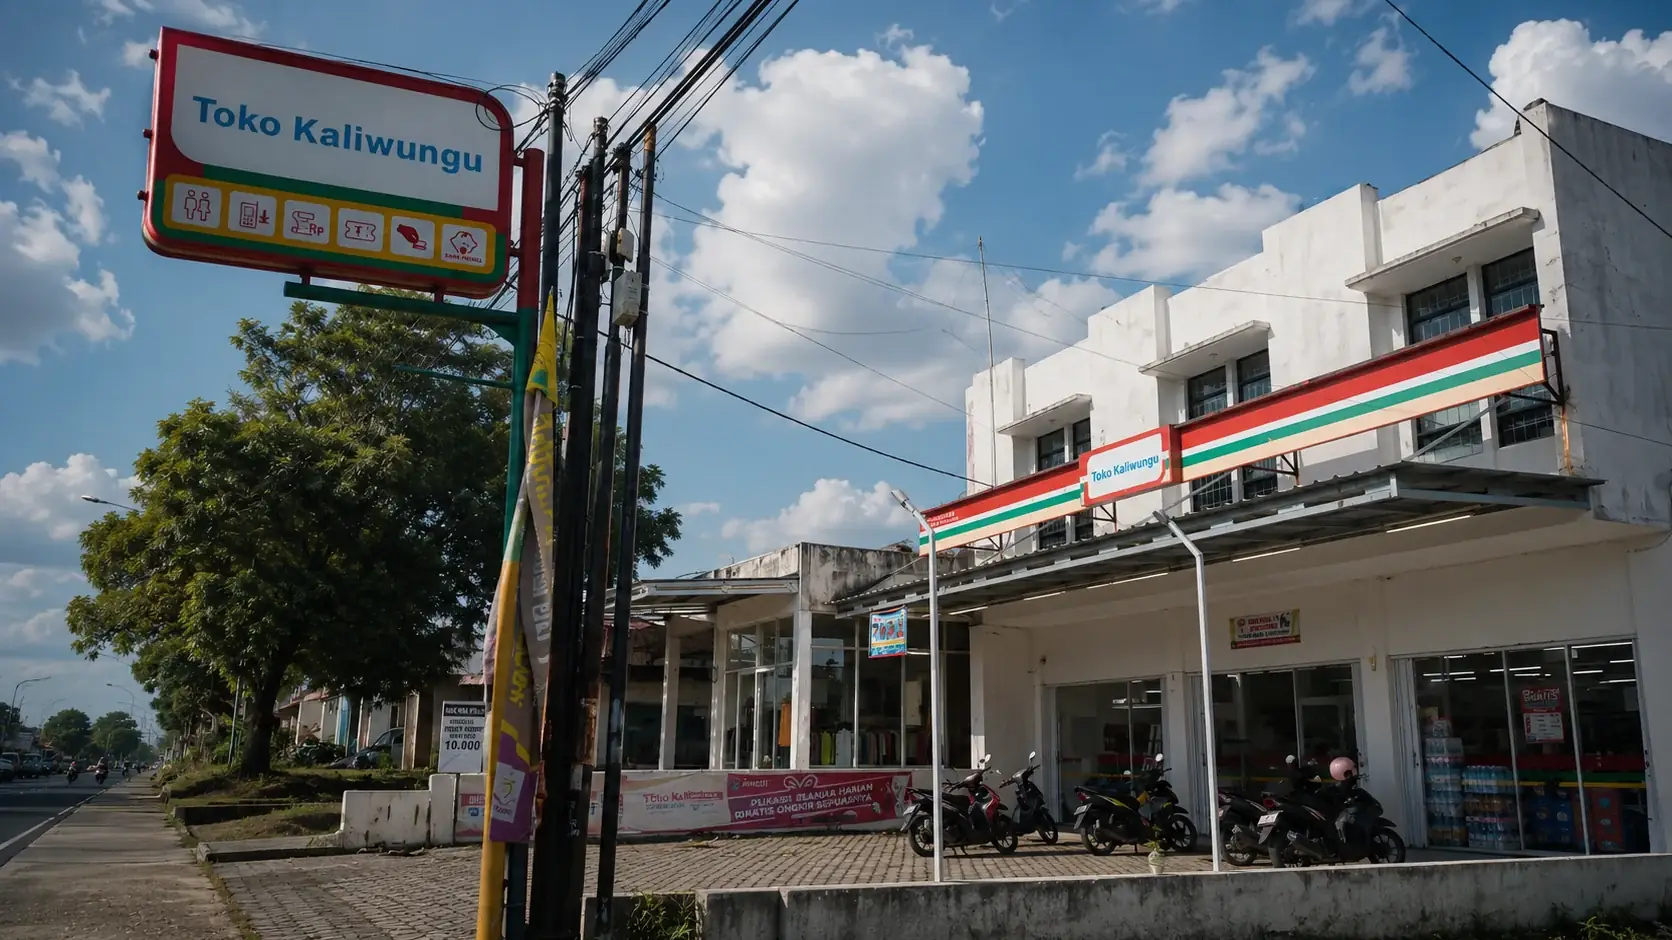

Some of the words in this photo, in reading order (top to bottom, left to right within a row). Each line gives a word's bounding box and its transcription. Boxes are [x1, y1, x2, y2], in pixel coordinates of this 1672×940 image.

[193, 96, 281, 136] Toko
[294, 116, 482, 174] Kaliwungu
[308, 224, 325, 237] Rp
[1091, 469, 1112, 482] Toko
[1113, 455, 1159, 476] Kaliwungu
[445, 740, 481, 751] 10.000
